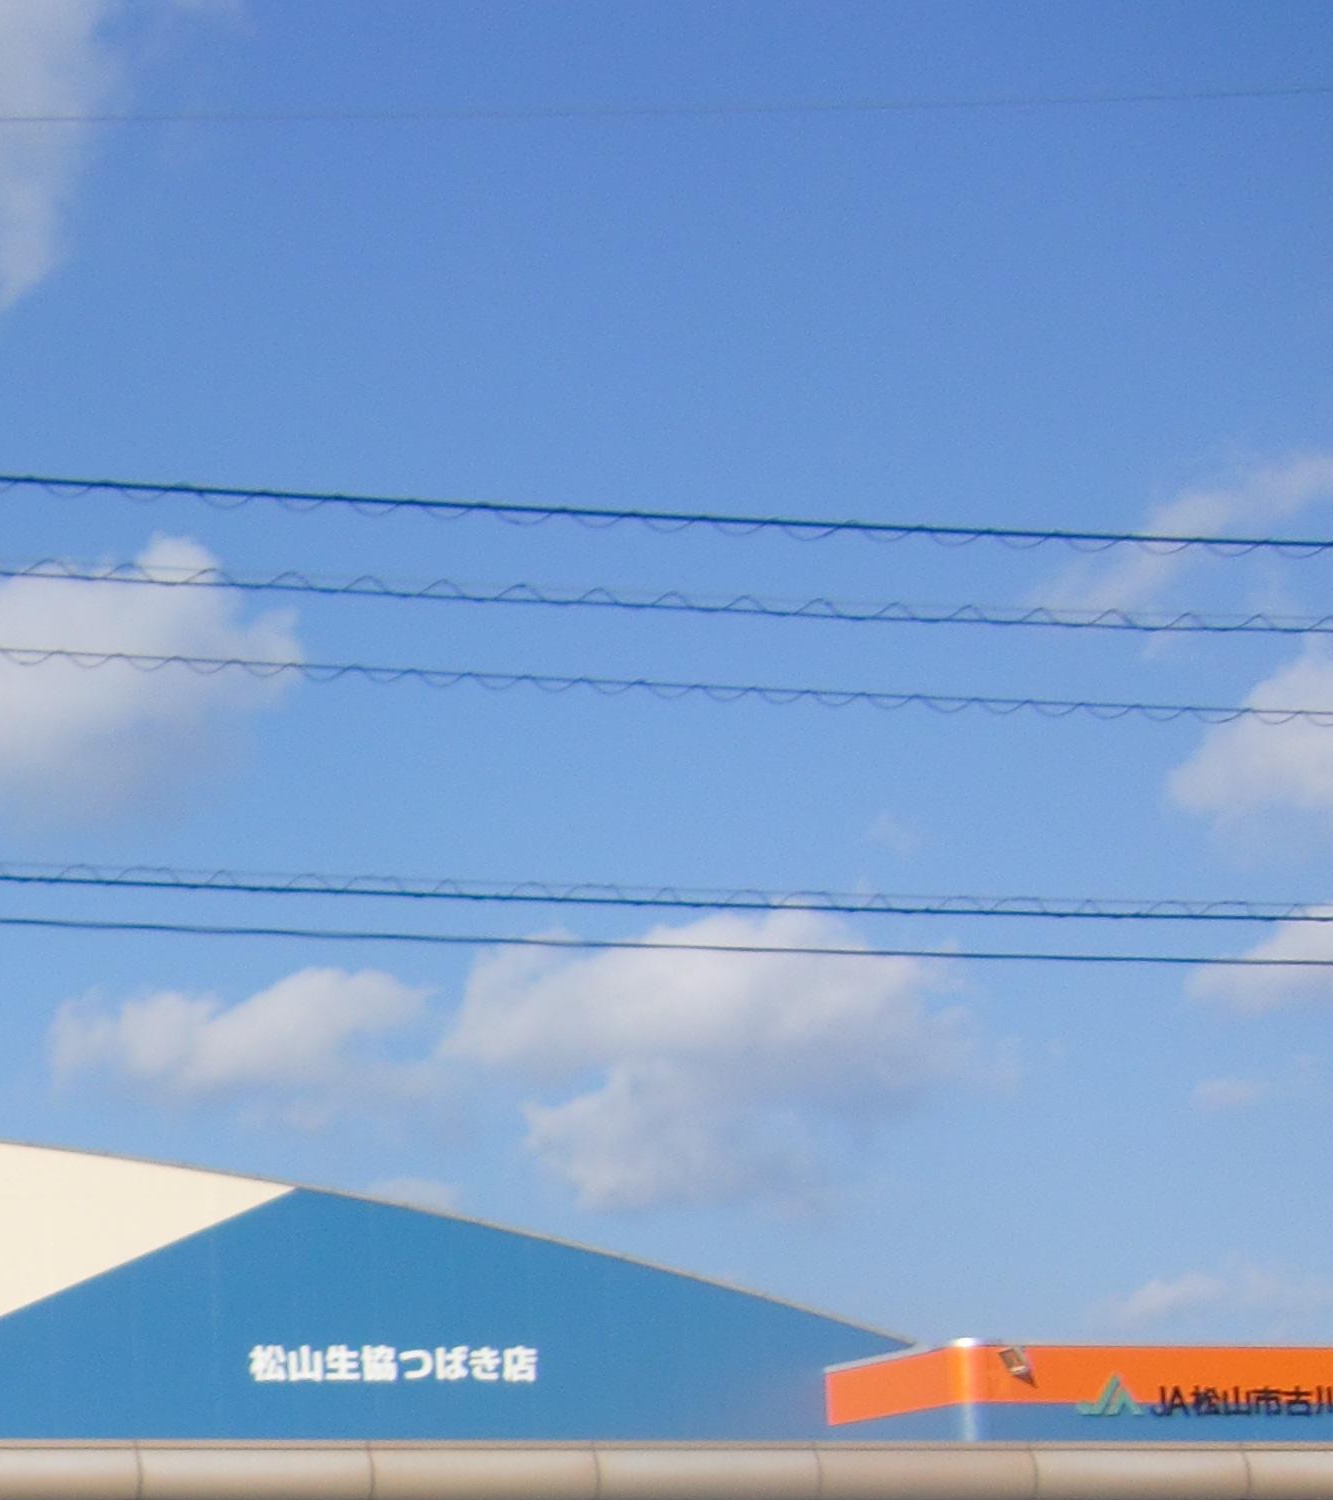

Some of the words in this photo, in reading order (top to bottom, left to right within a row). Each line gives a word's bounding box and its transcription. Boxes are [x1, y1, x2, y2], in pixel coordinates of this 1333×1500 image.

[248, 1344, 539, 1382] 松山生協つばき店
